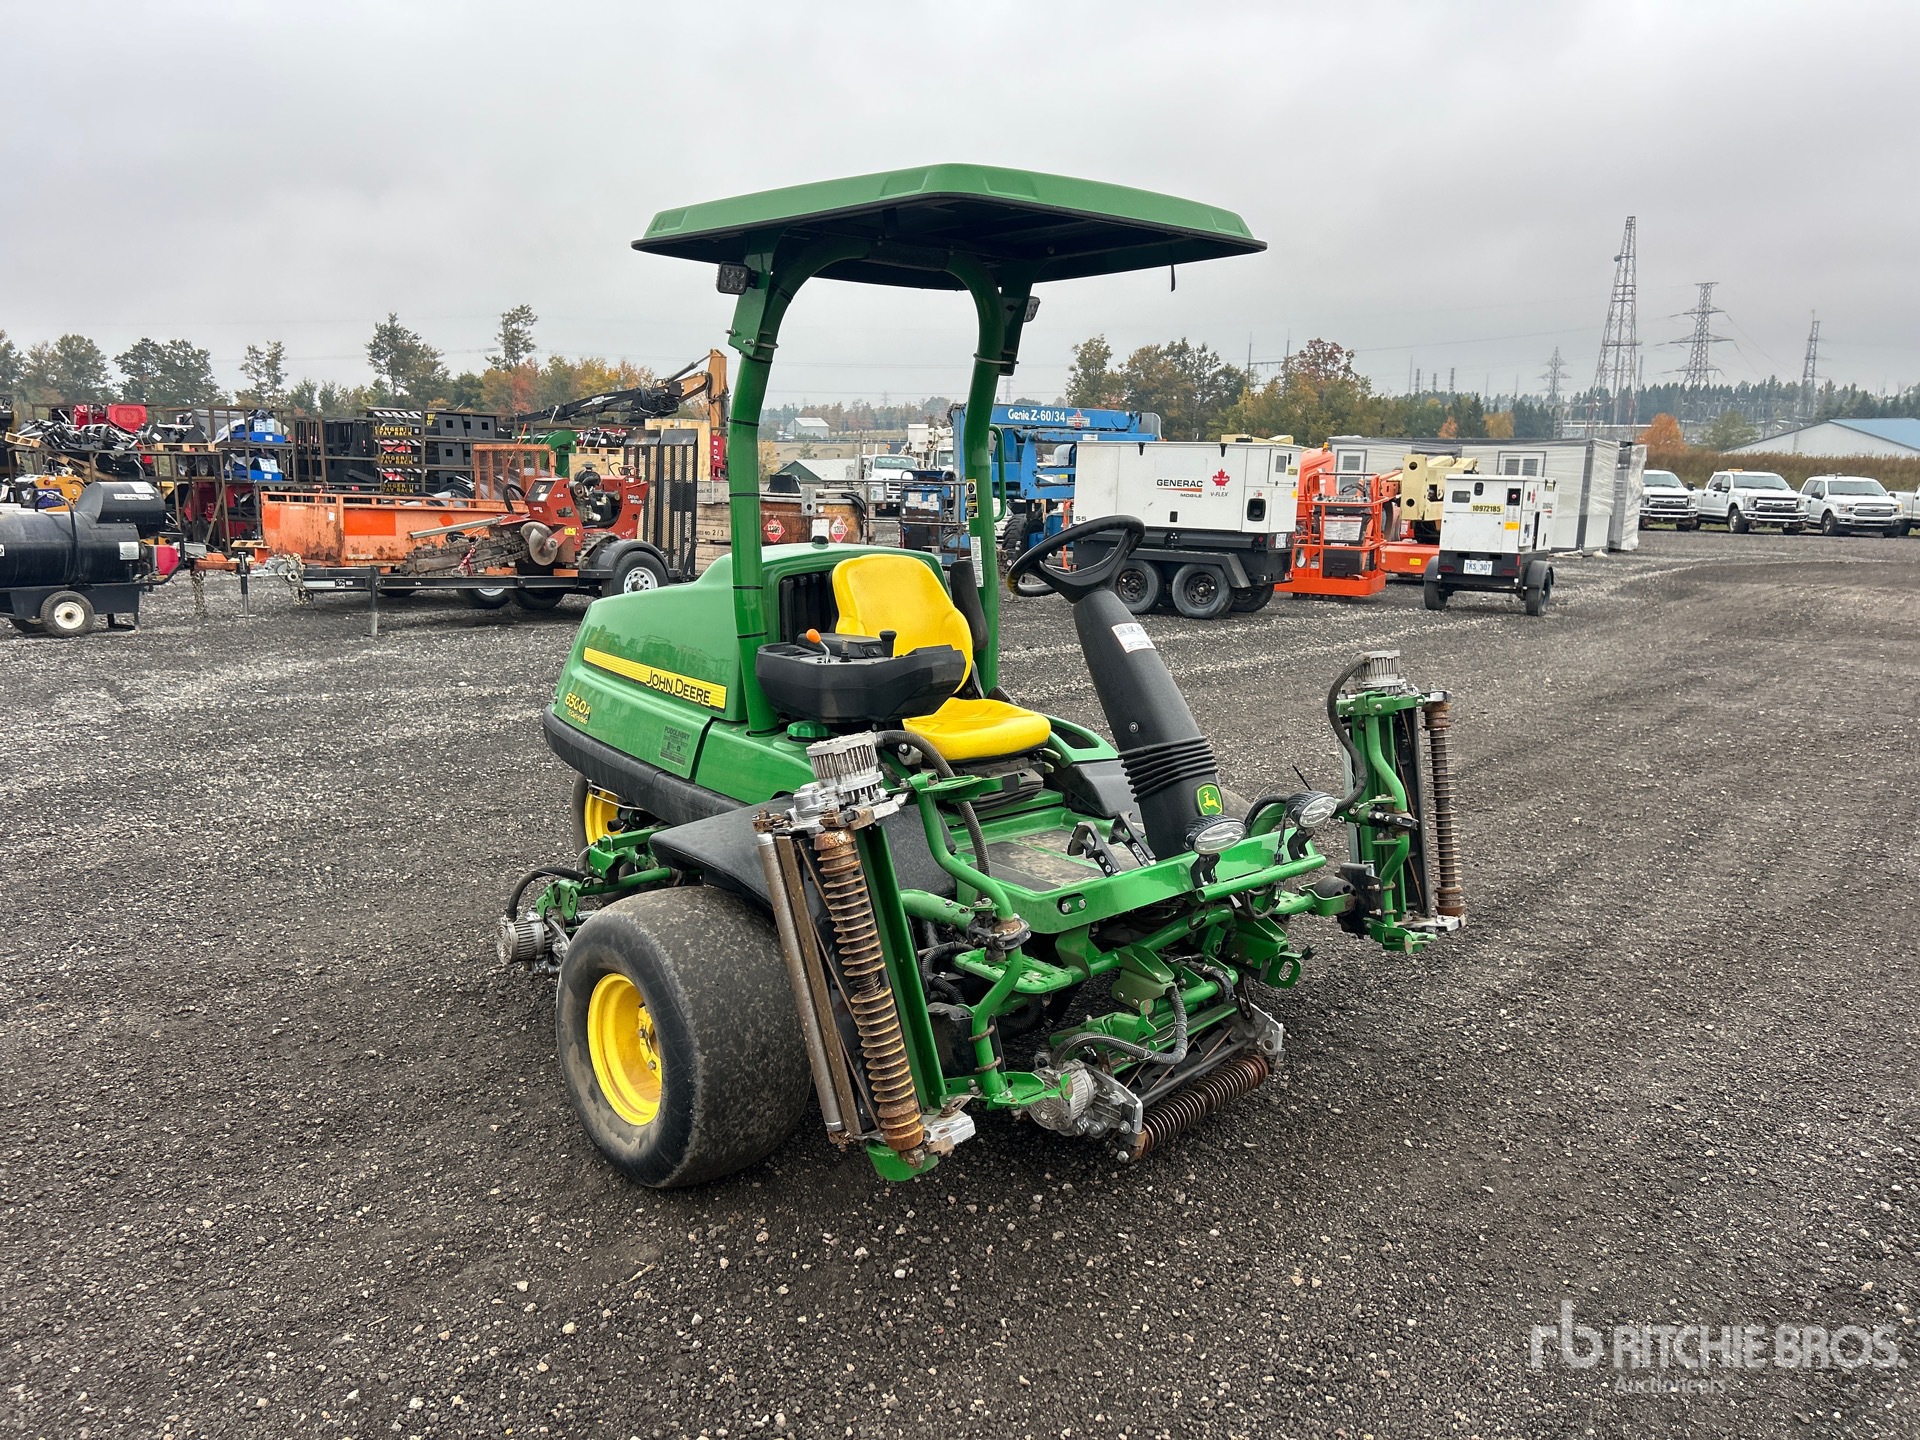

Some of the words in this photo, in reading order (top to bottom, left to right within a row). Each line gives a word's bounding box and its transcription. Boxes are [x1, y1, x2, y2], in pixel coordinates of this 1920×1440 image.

[1008, 408, 1029, 420] Genie
[1031, 410, 1065, 422] Z-60/34
[1156, 479, 1203, 488] GENERAC
[1472, 505, 1501, 513] 10972185
[1480, 563, 1491, 571] 307
[646, 670, 674, 692] JOHN
[675, 678, 712, 704] DEERE
[565, 692, 591, 715] 6500A
